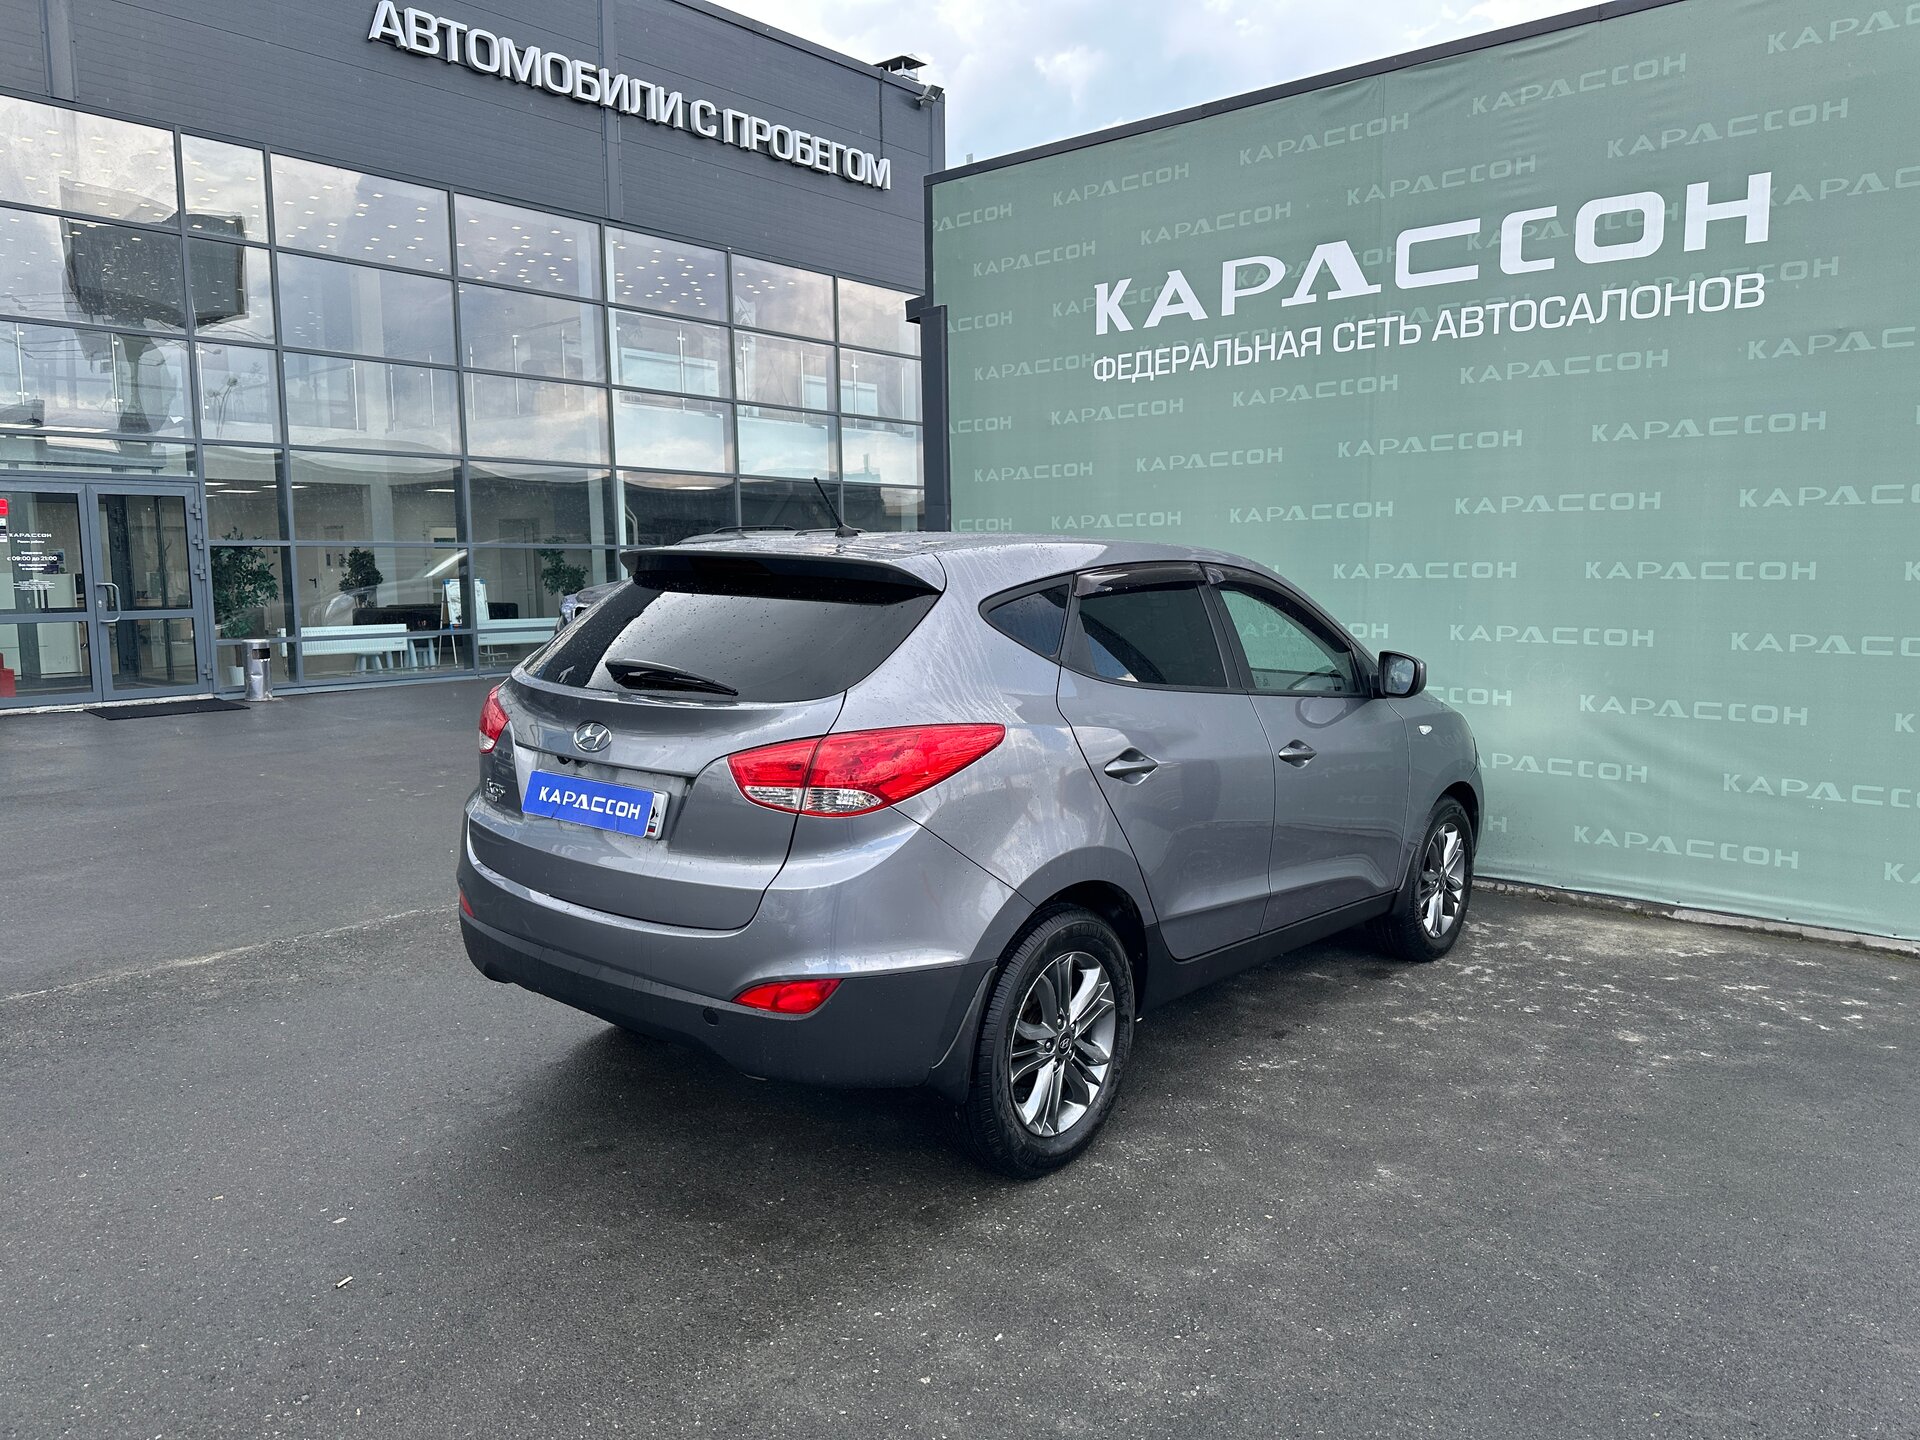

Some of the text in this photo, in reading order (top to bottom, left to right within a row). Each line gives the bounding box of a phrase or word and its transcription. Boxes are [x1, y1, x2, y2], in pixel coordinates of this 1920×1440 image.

[368, 0, 891, 190] АВТОМОБИЛИ С ПРОБЕГОМ
[1472, 53, 1687, 115] КАРАССОН
[1239, 112, 1409, 166] КАРАССОН
[1607, 97, 1849, 159] КАРАССОН
[1052, 162, 1190, 207] КАРАССОН
[1347, 154, 1536, 206] КАРАССОН
[1140, 202, 1292, 246] КАРАССОН
[974, 240, 1096, 277] КАРАССОН
[1094, 172, 1772, 335] КАРАССОН
[1093, 272, 1766, 383] ФЕДЕРАЛЬНАЯ СЕТЬ АВТОСАЛОНОВ
[974, 352, 1095, 381] КАРАССОН
[1460, 349, 1669, 385] КАРАССОН
[1233, 374, 1398, 407] КАРАССОН
[1051, 398, 1184, 426] КАРАССОН
[1591, 411, 1827, 442] КАРАССОН
[1136, 447, 1284, 473] КАРАССОН
[1338, 429, 1523, 459] КАРАССОН
[974, 462, 1093, 482] КАРАССОН
[1051, 510, 1182, 530] КАРАССОН
[1230, 501, 1394, 524] КАРАССОН
[1455, 492, 1662, 515] КАРАССОН
[1333, 562, 1517, 580] КАРАССОН
[1585, 561, 1817, 581] КАРАССОН
[1449, 624, 1655, 647] КАРАССОН
[1579, 694, 1808, 726] КАРАССОН
[538, 786, 641, 820] КАРАССОН
[1573, 826, 1799, 870] КАРАССОН
